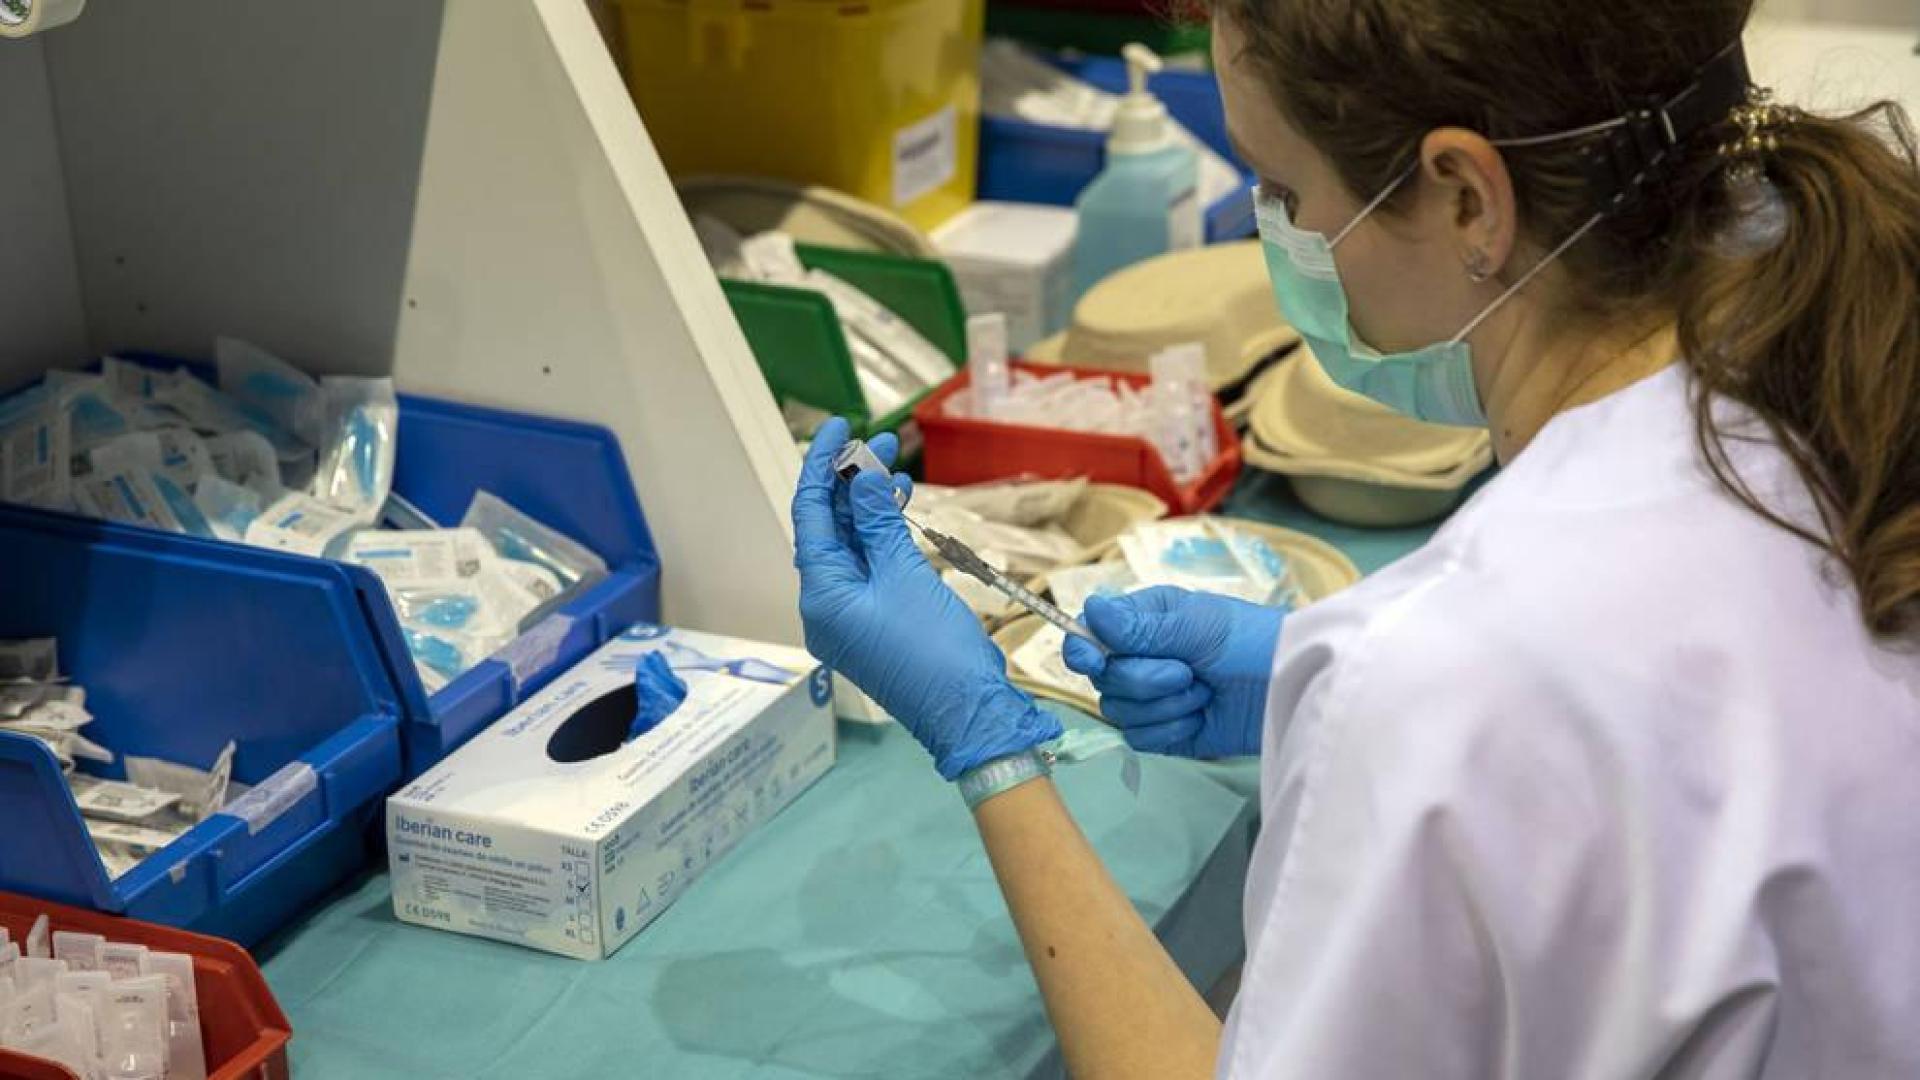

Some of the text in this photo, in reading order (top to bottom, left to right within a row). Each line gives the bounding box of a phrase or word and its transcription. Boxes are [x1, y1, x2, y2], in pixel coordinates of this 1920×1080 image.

[814, 668, 828, 698] S
[395, 814, 493, 848] Iberian care
